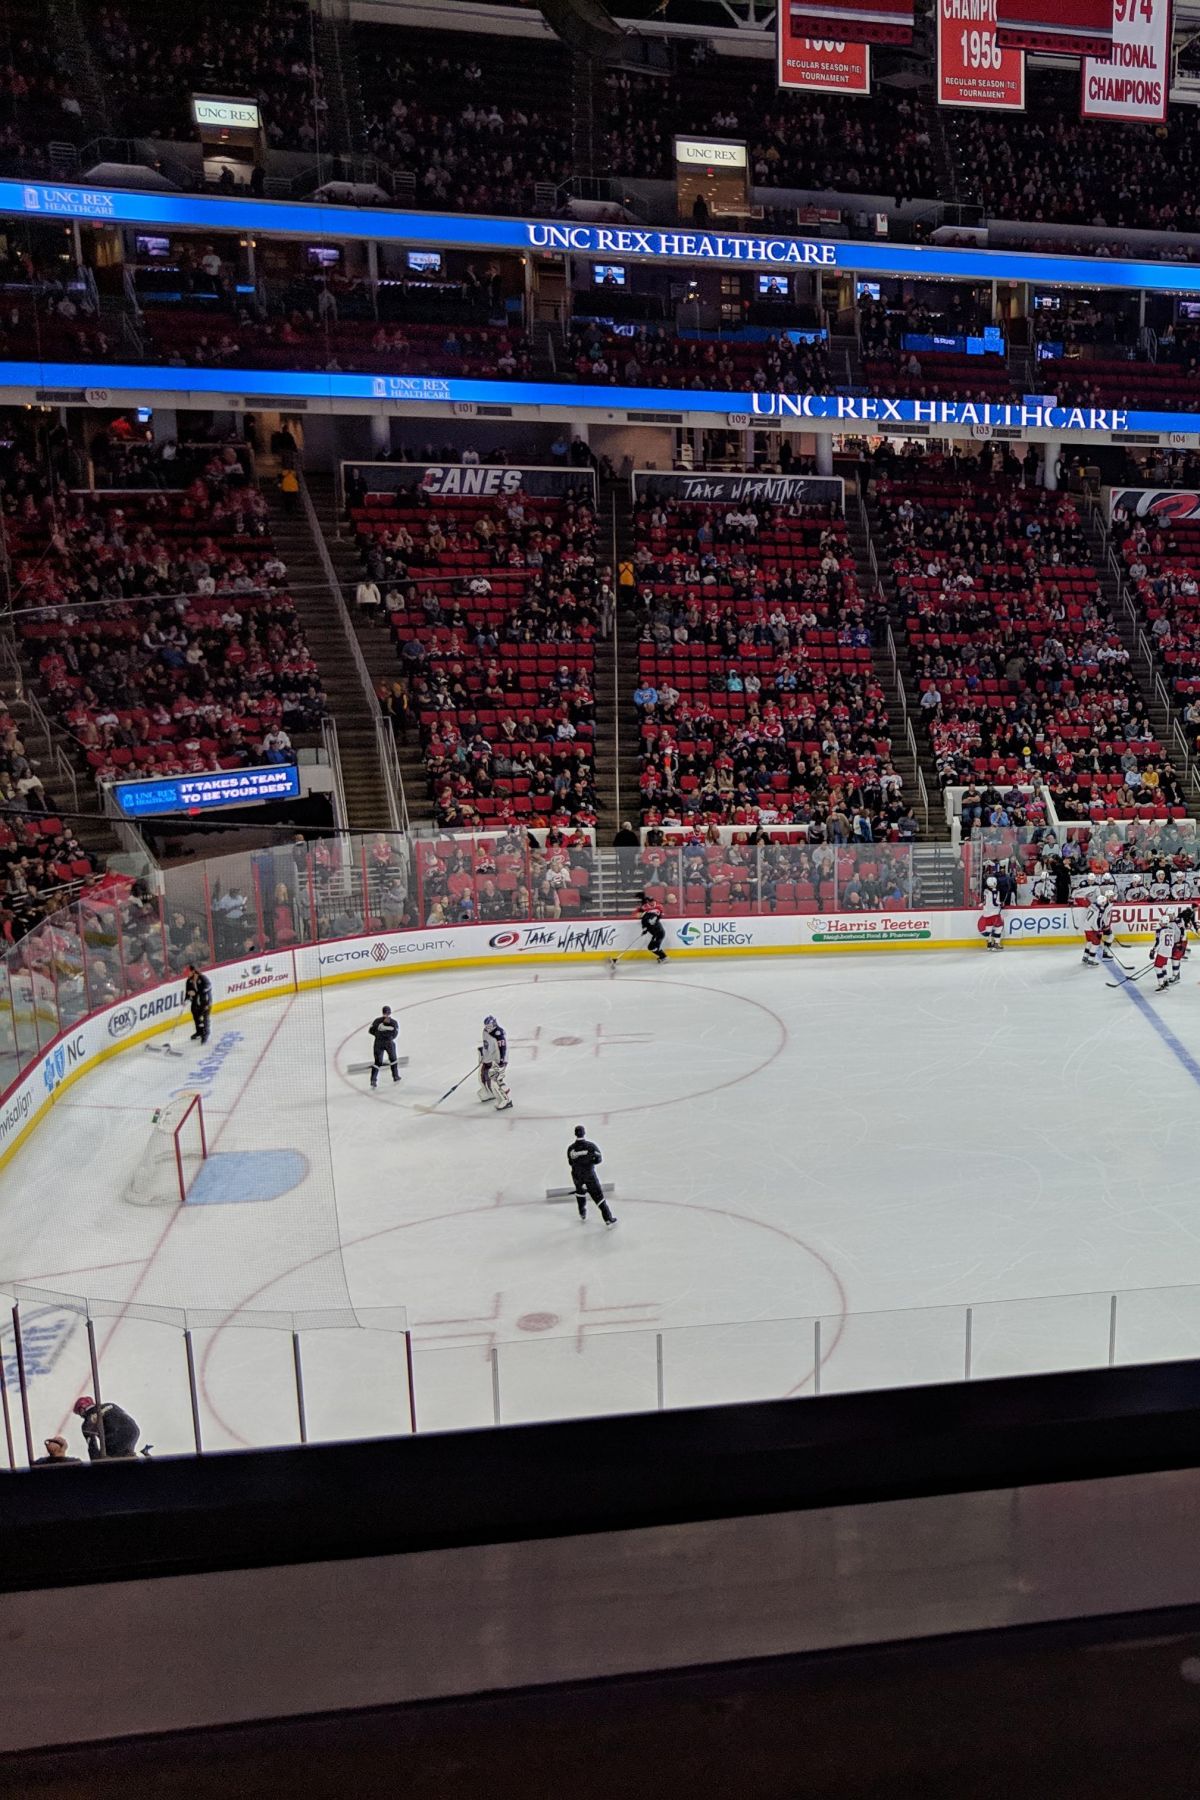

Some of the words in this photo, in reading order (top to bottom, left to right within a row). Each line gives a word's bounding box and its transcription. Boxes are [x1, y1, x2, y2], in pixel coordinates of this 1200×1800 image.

[961, 30, 1002, 70] 1956
[787, 60, 820, 71] REGULAR
[821, 63, 849, 73] SEASON
[801, 71, 850, 84] TOURNAMENT
[945, 78, 977, 88] REGULAR
[978, 80, 1004, 90] SEASON
[959, 89, 1005, 100] TOURNAMENT
[1088, 77, 1161, 106] CHAMPIONS
[198, 107, 228, 120] UNC
[230, 109, 257, 122] REX
[686, 147, 712, 159] UNC
[714, 149, 737, 162] REX
[43, 188, 81, 205] UNC
[83, 191, 115, 207] REX
[45, 202, 115, 215] HEALTHCARE
[526, 225, 591, 248] UNC
[597, 230, 651, 253] REX
[658, 235, 837, 265] HEALTHCARE
[390, 379, 420, 392] UNC
[423, 380, 450, 393] REX
[391, 391, 452, 401] HEALTHCARE
[458, 403, 475, 414] 101
[752, 393, 827, 418] UNC
[837, 397, 902, 421] REX
[913, 401, 1129, 432] HEALTHCARE
[731, 414, 748, 424] 102
[975, 425, 992, 435] 103
[1172, 433, 1186, 444] 104
[422, 468, 523, 501] CANES
[181, 784, 192, 793] IT
[192, 778, 239, 792] TAKES
[239, 777, 249, 787] A
[249, 772, 287, 785] TEAM
[182, 793, 202, 803] TO
[202, 791, 221, 801] BE
[220, 785, 259, 799] YOUR
[259, 782, 293, 793] BEST
[704, 922, 737, 933] DUKE
[828, 920, 878, 932] Harris
[880, 918, 930, 931] Teeter
[1009, 913, 1067, 934] pepsi
[704, 934, 754, 945] ENERGY
[319, 949, 370, 964] VECTOR
[390, 940, 455, 955] SECURITY
[114, 1010, 131, 1028] FOX
[67, 1035, 87, 1062] NC
